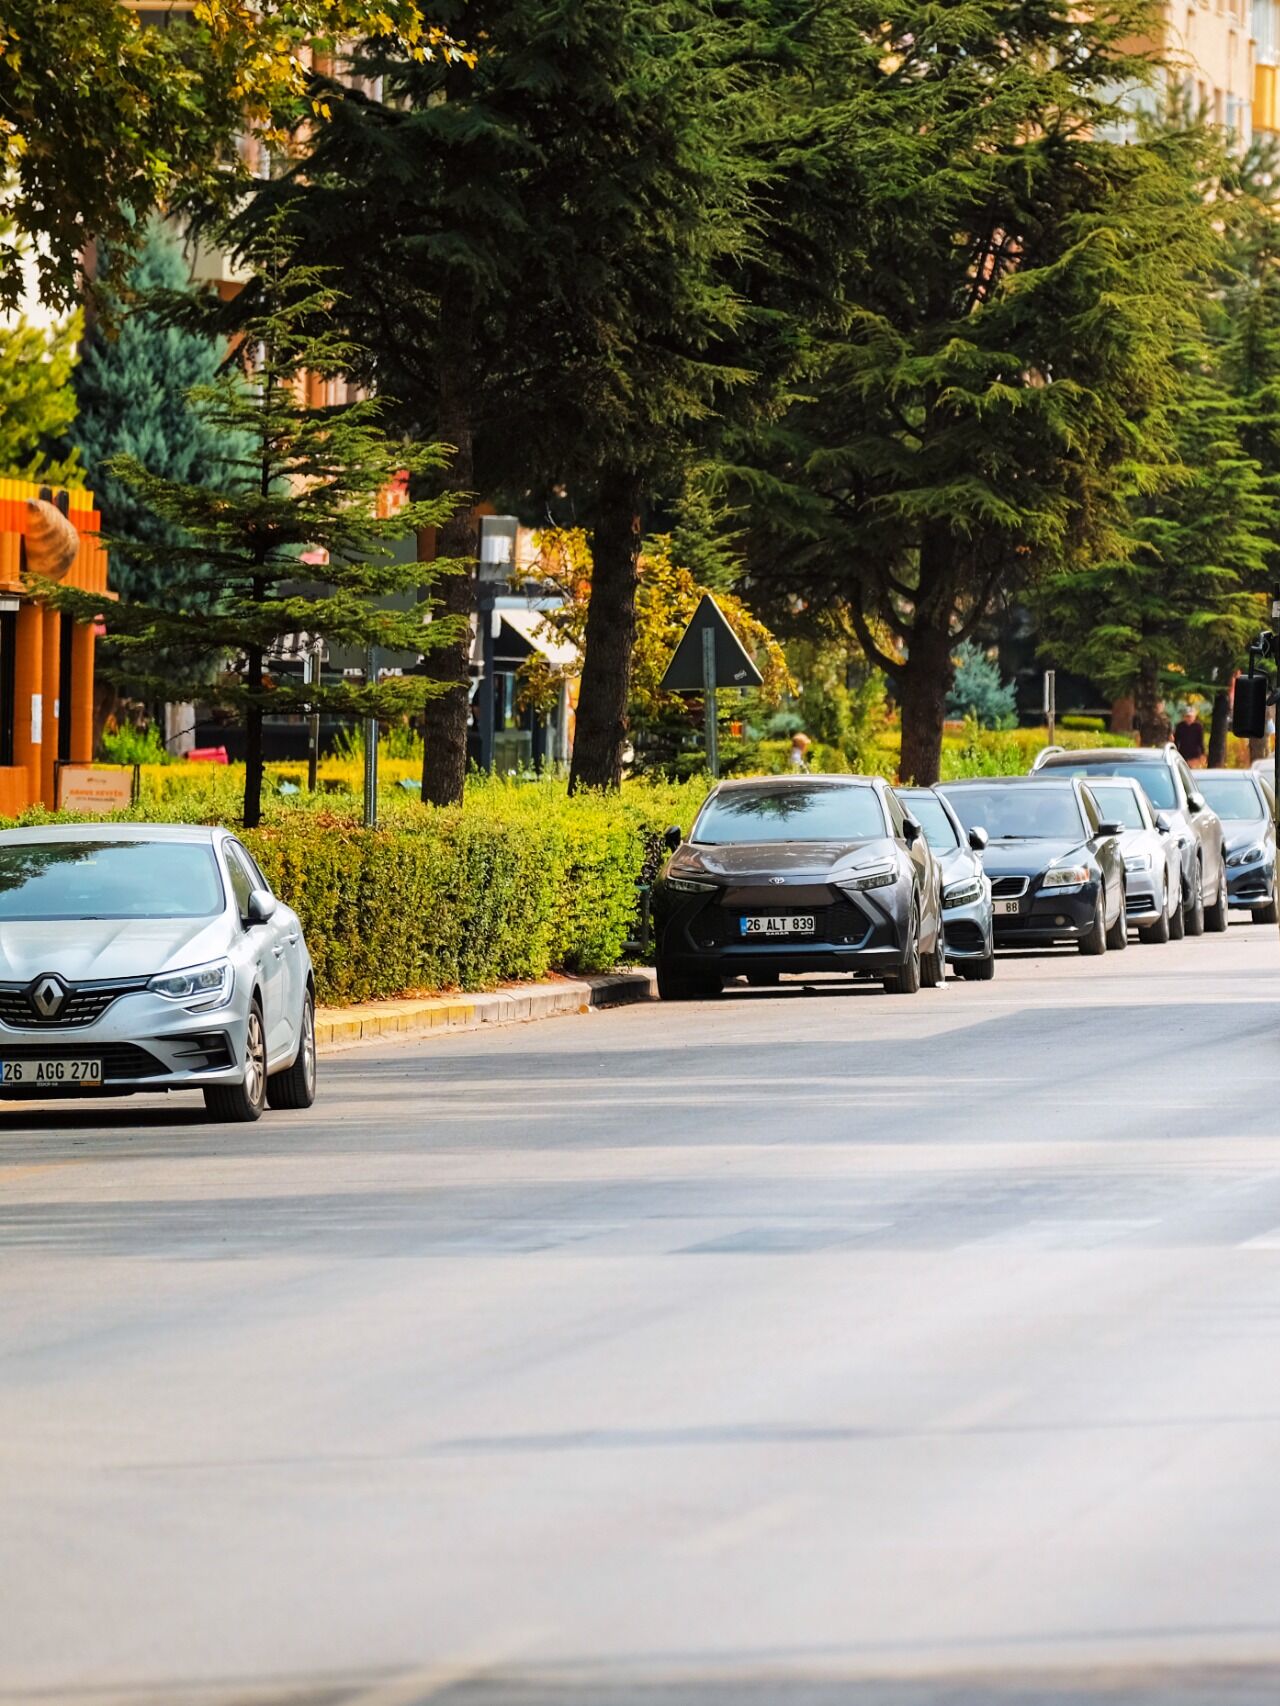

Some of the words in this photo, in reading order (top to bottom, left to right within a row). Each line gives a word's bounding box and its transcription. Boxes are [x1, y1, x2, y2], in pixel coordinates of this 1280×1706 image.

[1006, 902, 1017, 912] 88
[747, 919, 760, 930] 26
[767, 919, 787, 930] ALT
[792, 918, 813, 929] 839
[3, 1063, 22, 1080] 26
[36, 1062, 64, 1080] AGG
[71, 1062, 99, 1079] 270
